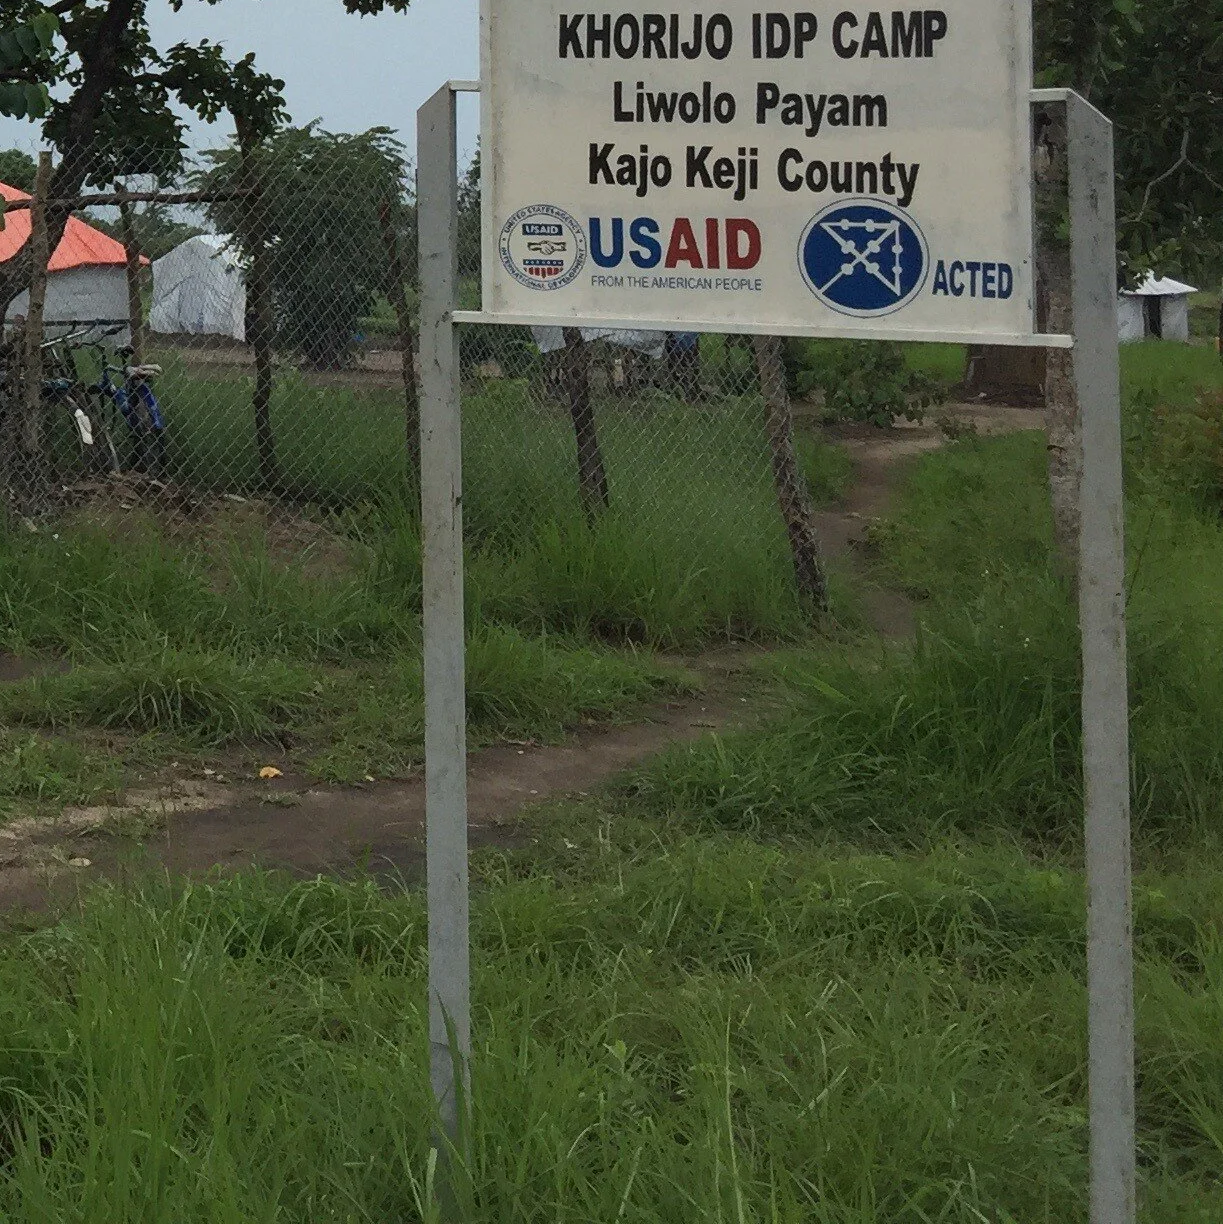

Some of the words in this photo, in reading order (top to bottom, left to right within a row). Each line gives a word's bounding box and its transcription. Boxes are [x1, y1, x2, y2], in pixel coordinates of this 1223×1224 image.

[558, 13, 733, 60] KHORIJO
[752, 12, 817, 59] IDP
[832, 10, 948, 59] CAMP
[614, 81, 736, 124] Liwolo
[756, 82, 888, 137] Payam
[588, 143, 672, 197] Kajo
[686, 146, 759, 201] Keji
[778, 148, 920, 207] County
[504, 210, 526, 234] UNITED
[527, 206, 554, 215] STATES
[555, 210, 581, 235] AGENCY
[525, 225, 559, 234] USAID
[589, 217, 762, 269] USAID
[591, 275, 624, 288] FROM
[627, 275, 650, 289] THE
[651, 276, 712, 291] AMERICAN
[715, 278, 762, 292] PEOPLE
[932, 260, 1014, 299] ACTED
